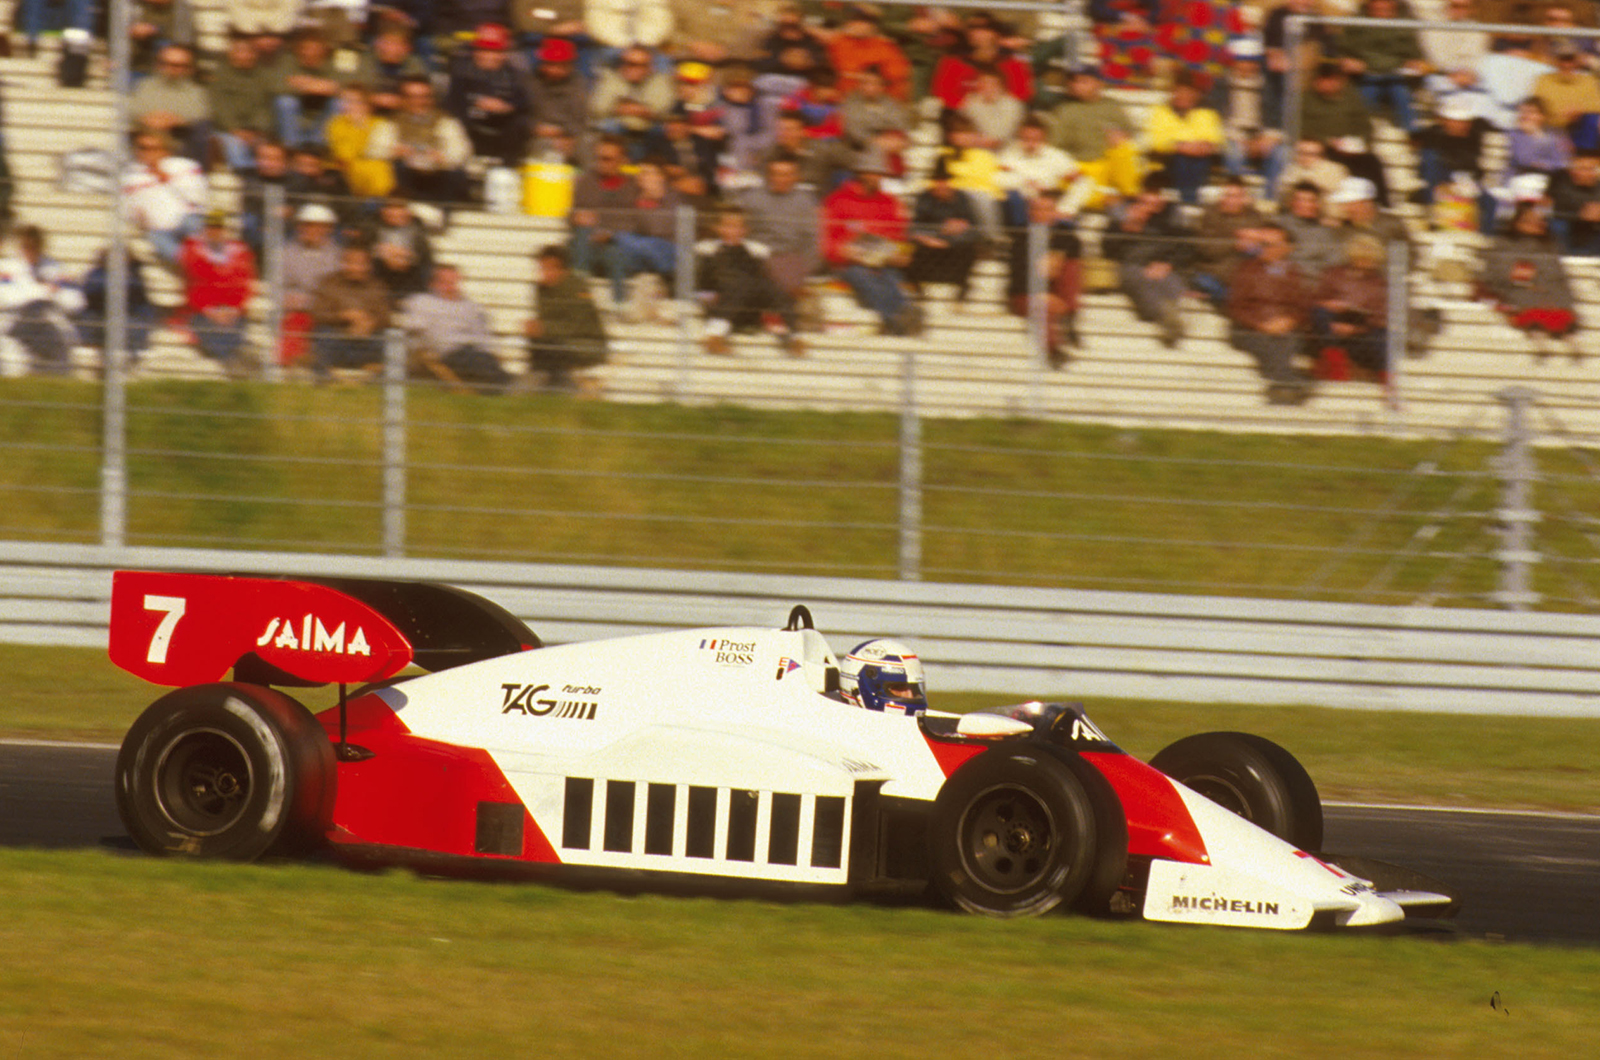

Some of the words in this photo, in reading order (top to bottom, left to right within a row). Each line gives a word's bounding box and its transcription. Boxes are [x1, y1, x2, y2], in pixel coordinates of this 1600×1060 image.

[143, 594, 186, 664] 7
[257, 613, 371, 656] SAIMA
[715, 651, 754, 665] BOSS
[719, 639, 757, 652] Prost
[501, 683, 558, 717] TAG
[1172, 895, 1279, 915] MICHELIN
